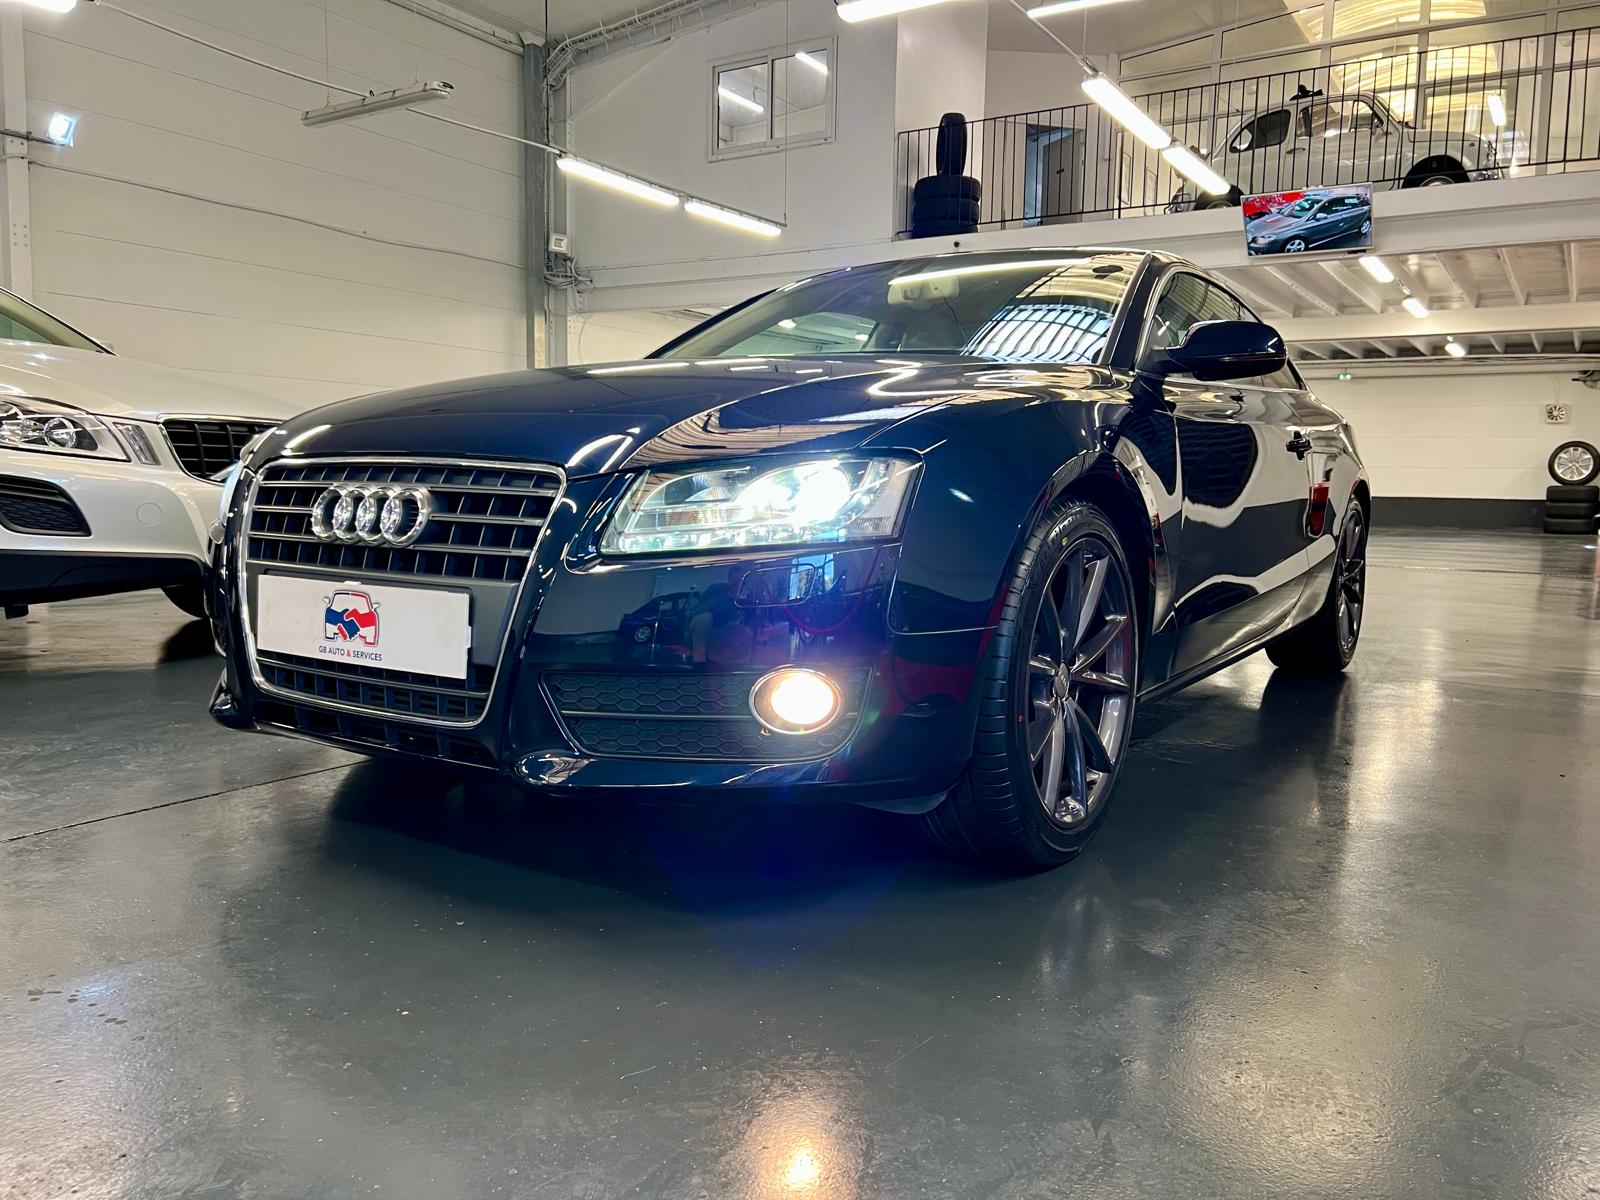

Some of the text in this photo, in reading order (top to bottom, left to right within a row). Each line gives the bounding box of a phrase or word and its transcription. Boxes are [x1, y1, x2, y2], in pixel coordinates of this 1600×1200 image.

[319, 645, 383, 661] GB AUTO & SERVICES
